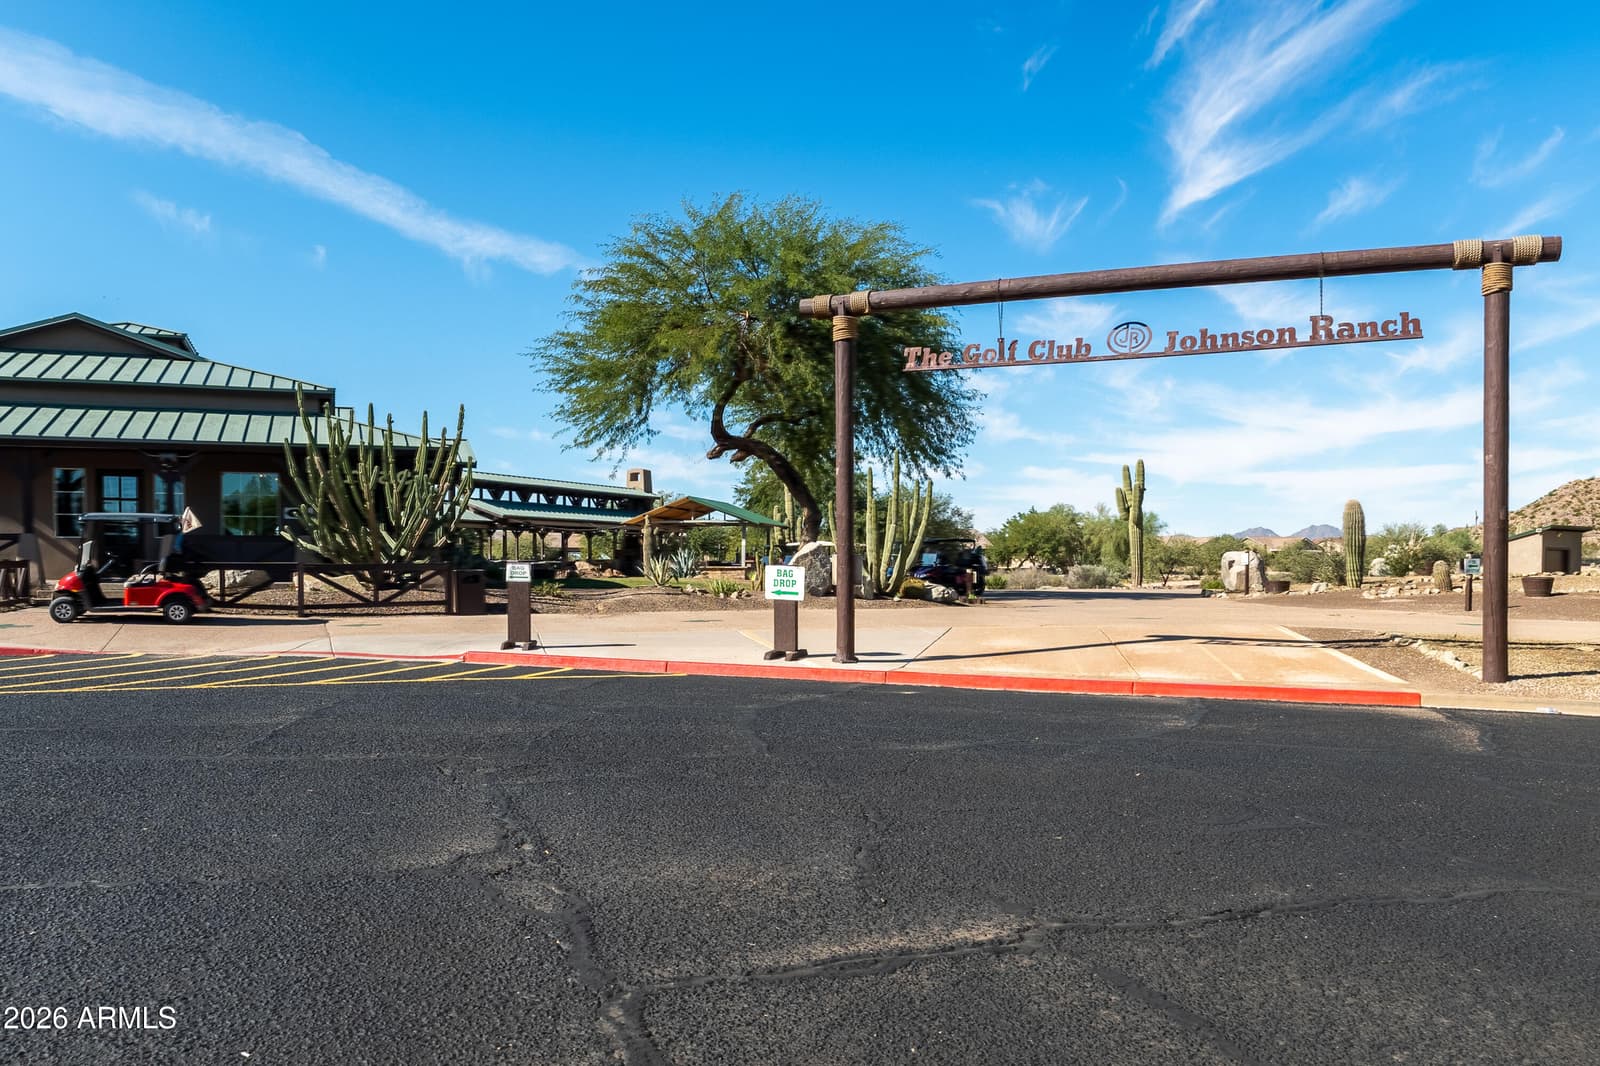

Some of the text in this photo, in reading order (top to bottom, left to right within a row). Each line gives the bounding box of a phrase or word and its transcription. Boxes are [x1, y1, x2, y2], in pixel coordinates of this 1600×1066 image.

[903, 346, 953, 369] The
[962, 337, 1019, 364] Golf
[1028, 337, 1092, 361] Club
[1164, 328, 1297, 354] Johnson
[1309, 311, 1422, 342] Ranch
[776, 568, 794, 578] BAG
[773, 578, 797, 588] DROP
